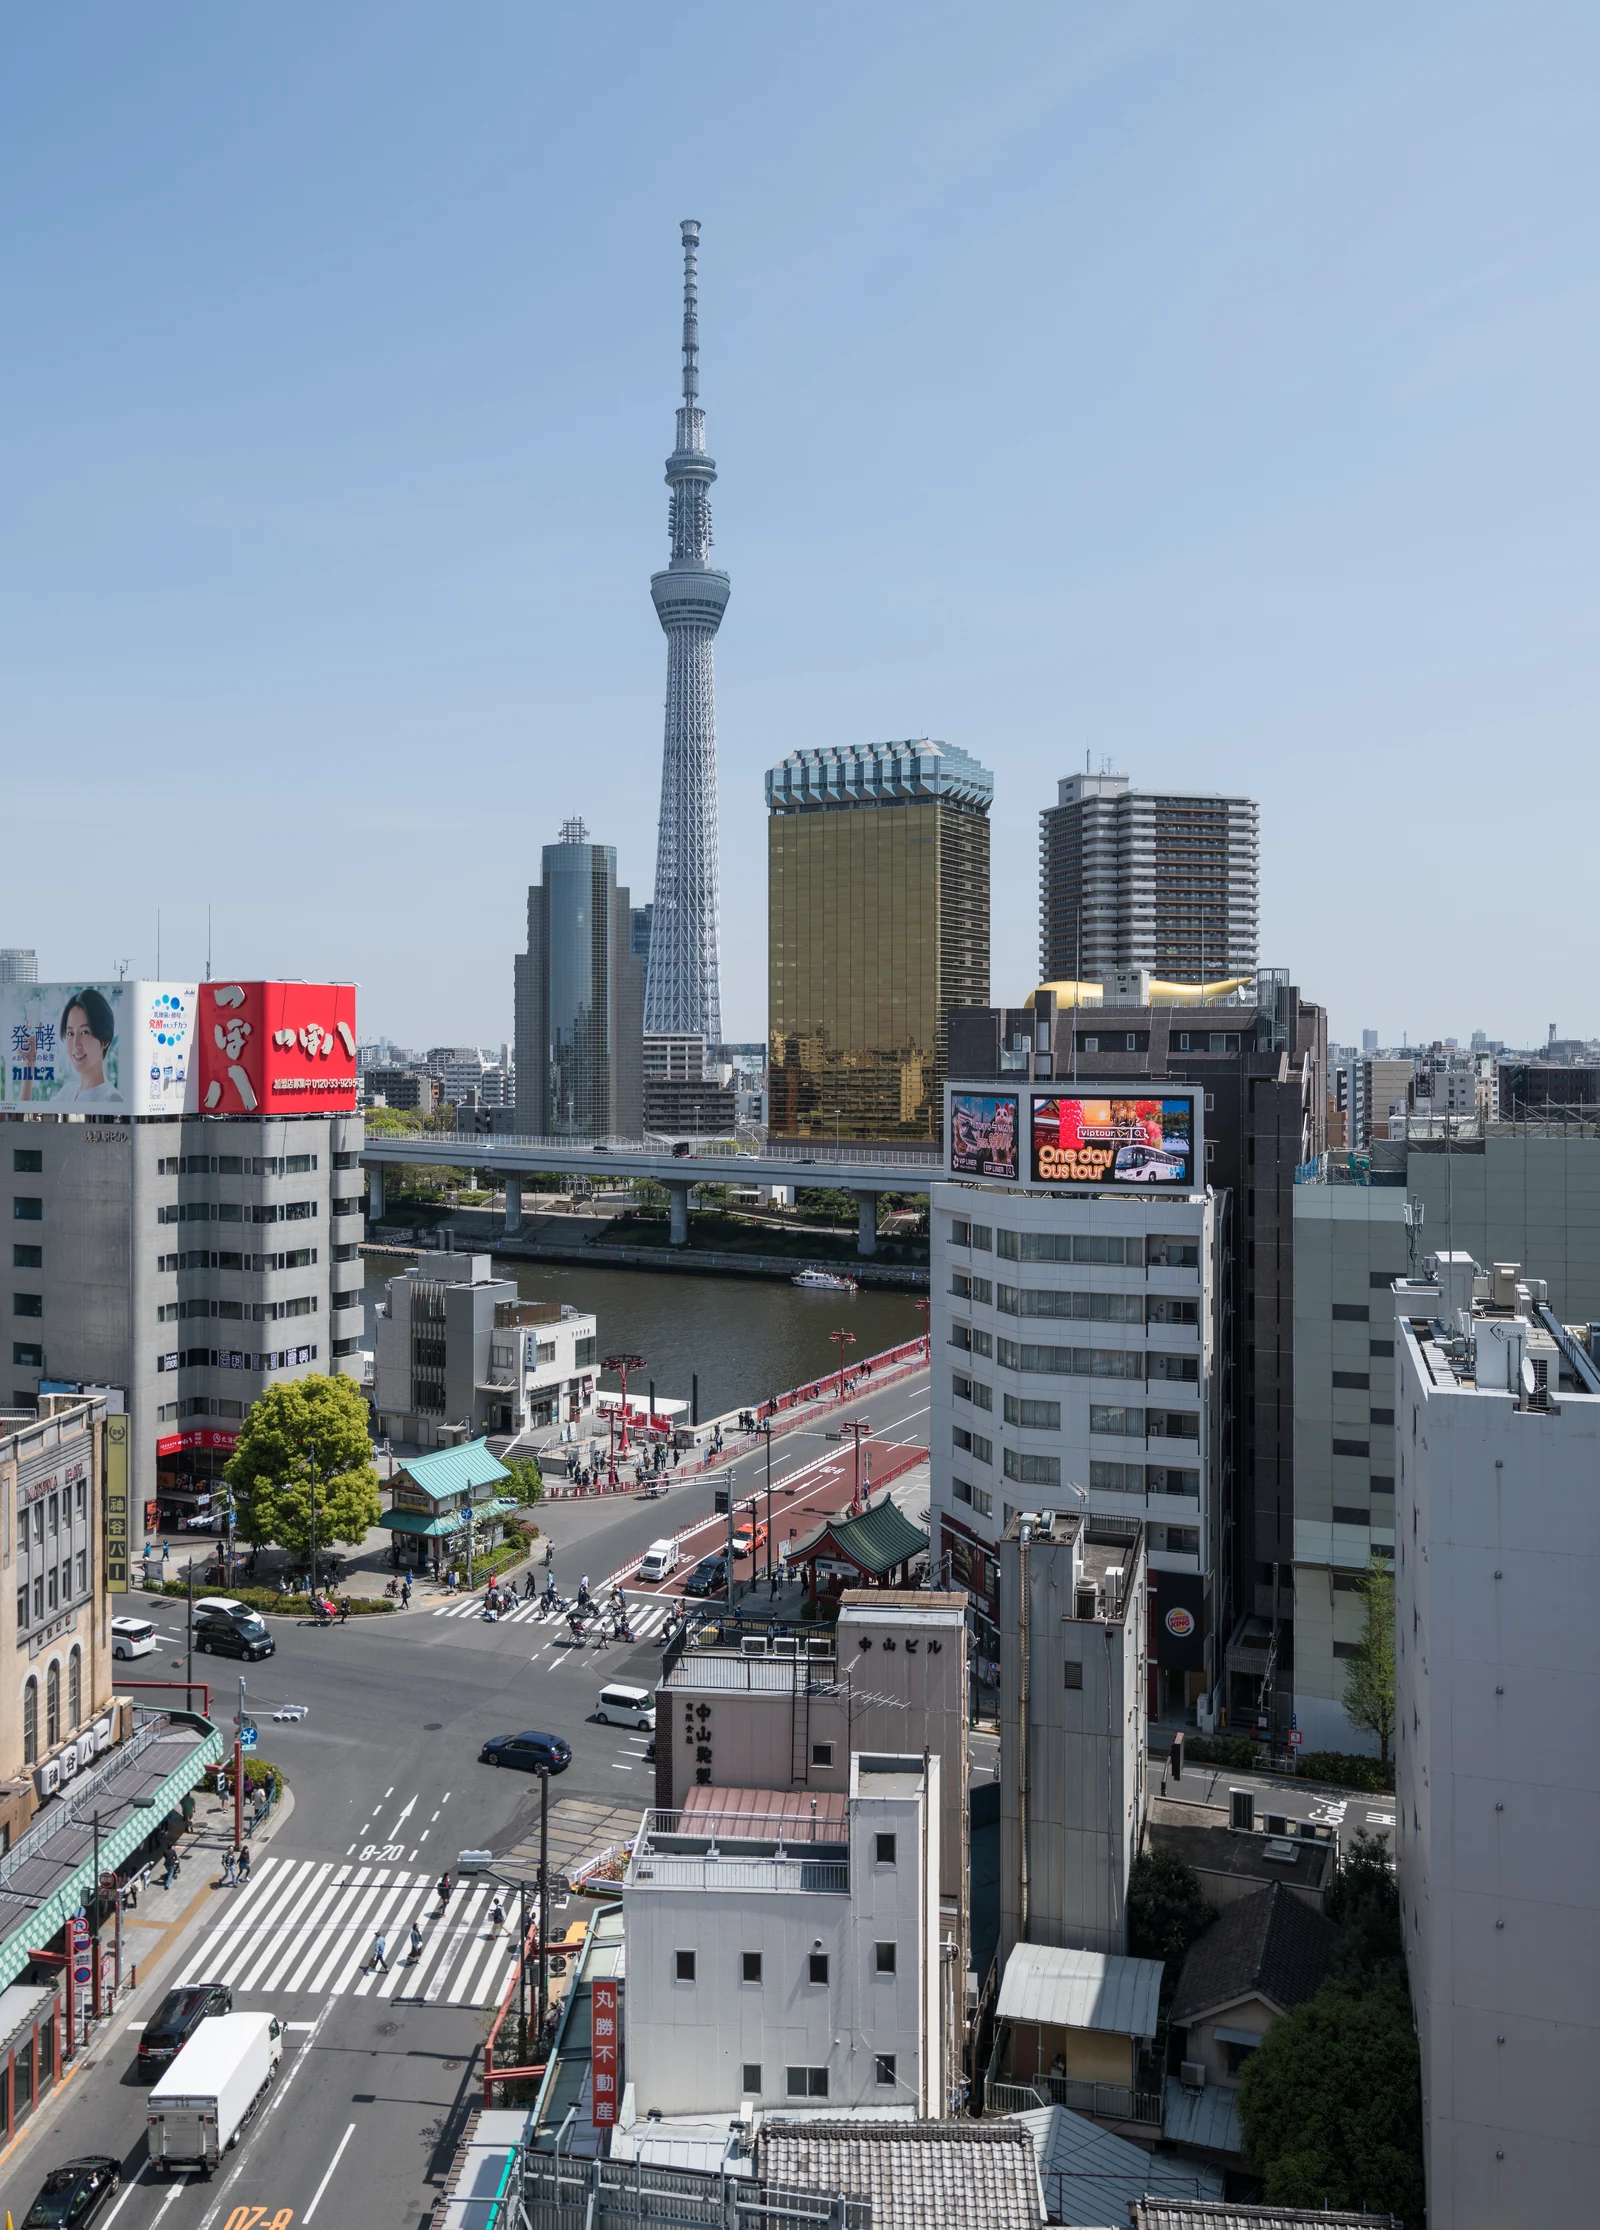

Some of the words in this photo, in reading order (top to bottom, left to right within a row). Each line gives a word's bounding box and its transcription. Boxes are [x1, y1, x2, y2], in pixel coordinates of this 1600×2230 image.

[11, 1024, 55, 1051] 発酵
[204, 986, 257, 1111] つぼ八
[274, 1022, 356, 1056] つぼ八
[12, 1066, 55, 1080] カルピス
[1081, 1129, 1115, 1137] viptour
[1039, 1145, 1077, 1163] One
[1079, 1146, 1113, 1167] day
[1039, 1161, 1070, 1179] bus
[1070, 1162, 1105, 1179] tour
[65, 1462, 83, 1482] BAR
[110, 1498, 124, 1579] 神谷バー
[1171, 1619, 1190, 1628] KING
[859, 1636, 941, 1654] 中山ビル
[685, 1702, 694, 1744] 有限会社
[48, 1730, 108, 1788] 神谷バー
[359, 1844, 405, 1861] 8-20
[595, 1989, 614, 2120] 丸勝不動産
